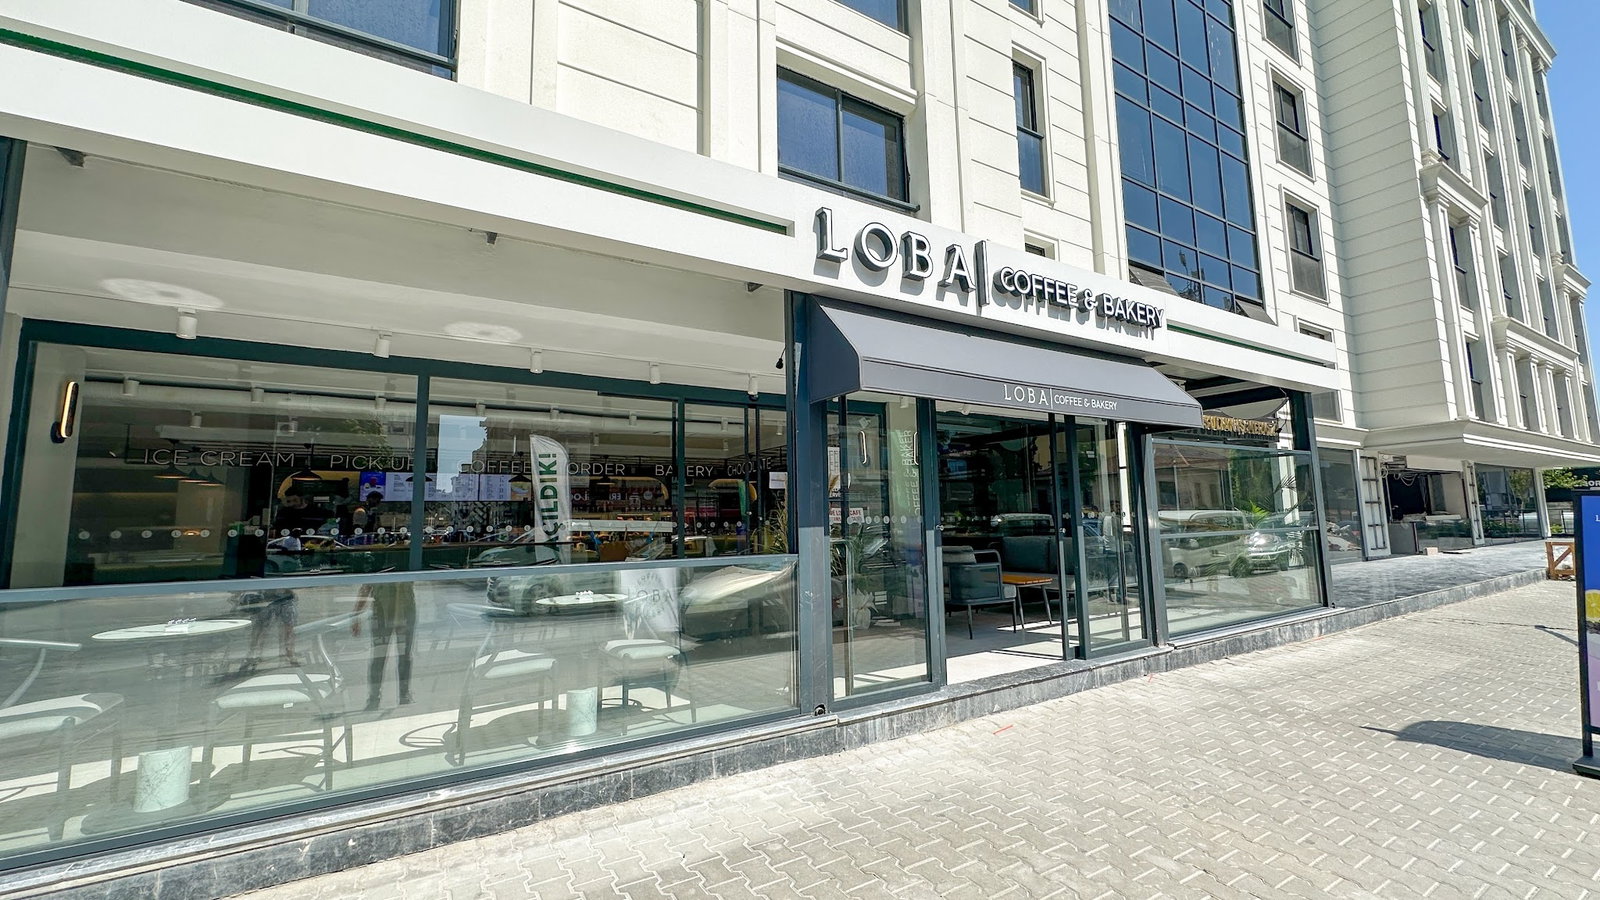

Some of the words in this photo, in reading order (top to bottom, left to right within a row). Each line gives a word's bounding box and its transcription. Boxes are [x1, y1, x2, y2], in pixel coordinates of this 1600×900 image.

[816, 206, 976, 293] LOBA
[996, 266, 1079, 307] COFFEE
[1081, 289, 1098, 311] &
[1099, 293, 1164, 328] BAKERY
[1003, 384, 1049, 406] LOBA
[1054, 394, 1082, 407] COFFEE
[1084, 398, 1091, 407] &
[1092, 398, 1118, 411] BAKERY
[143, 448, 189, 466] ICE
[200, 450, 295, 468] CREAM
[330, 454, 383, 470] PICK
[456, 460, 532, 474] COFFEE
[727, 456, 772, 477] CHOCOLTE
[567, 462, 626, 475] ORDER
[655, 464, 714, 477] BAERY
